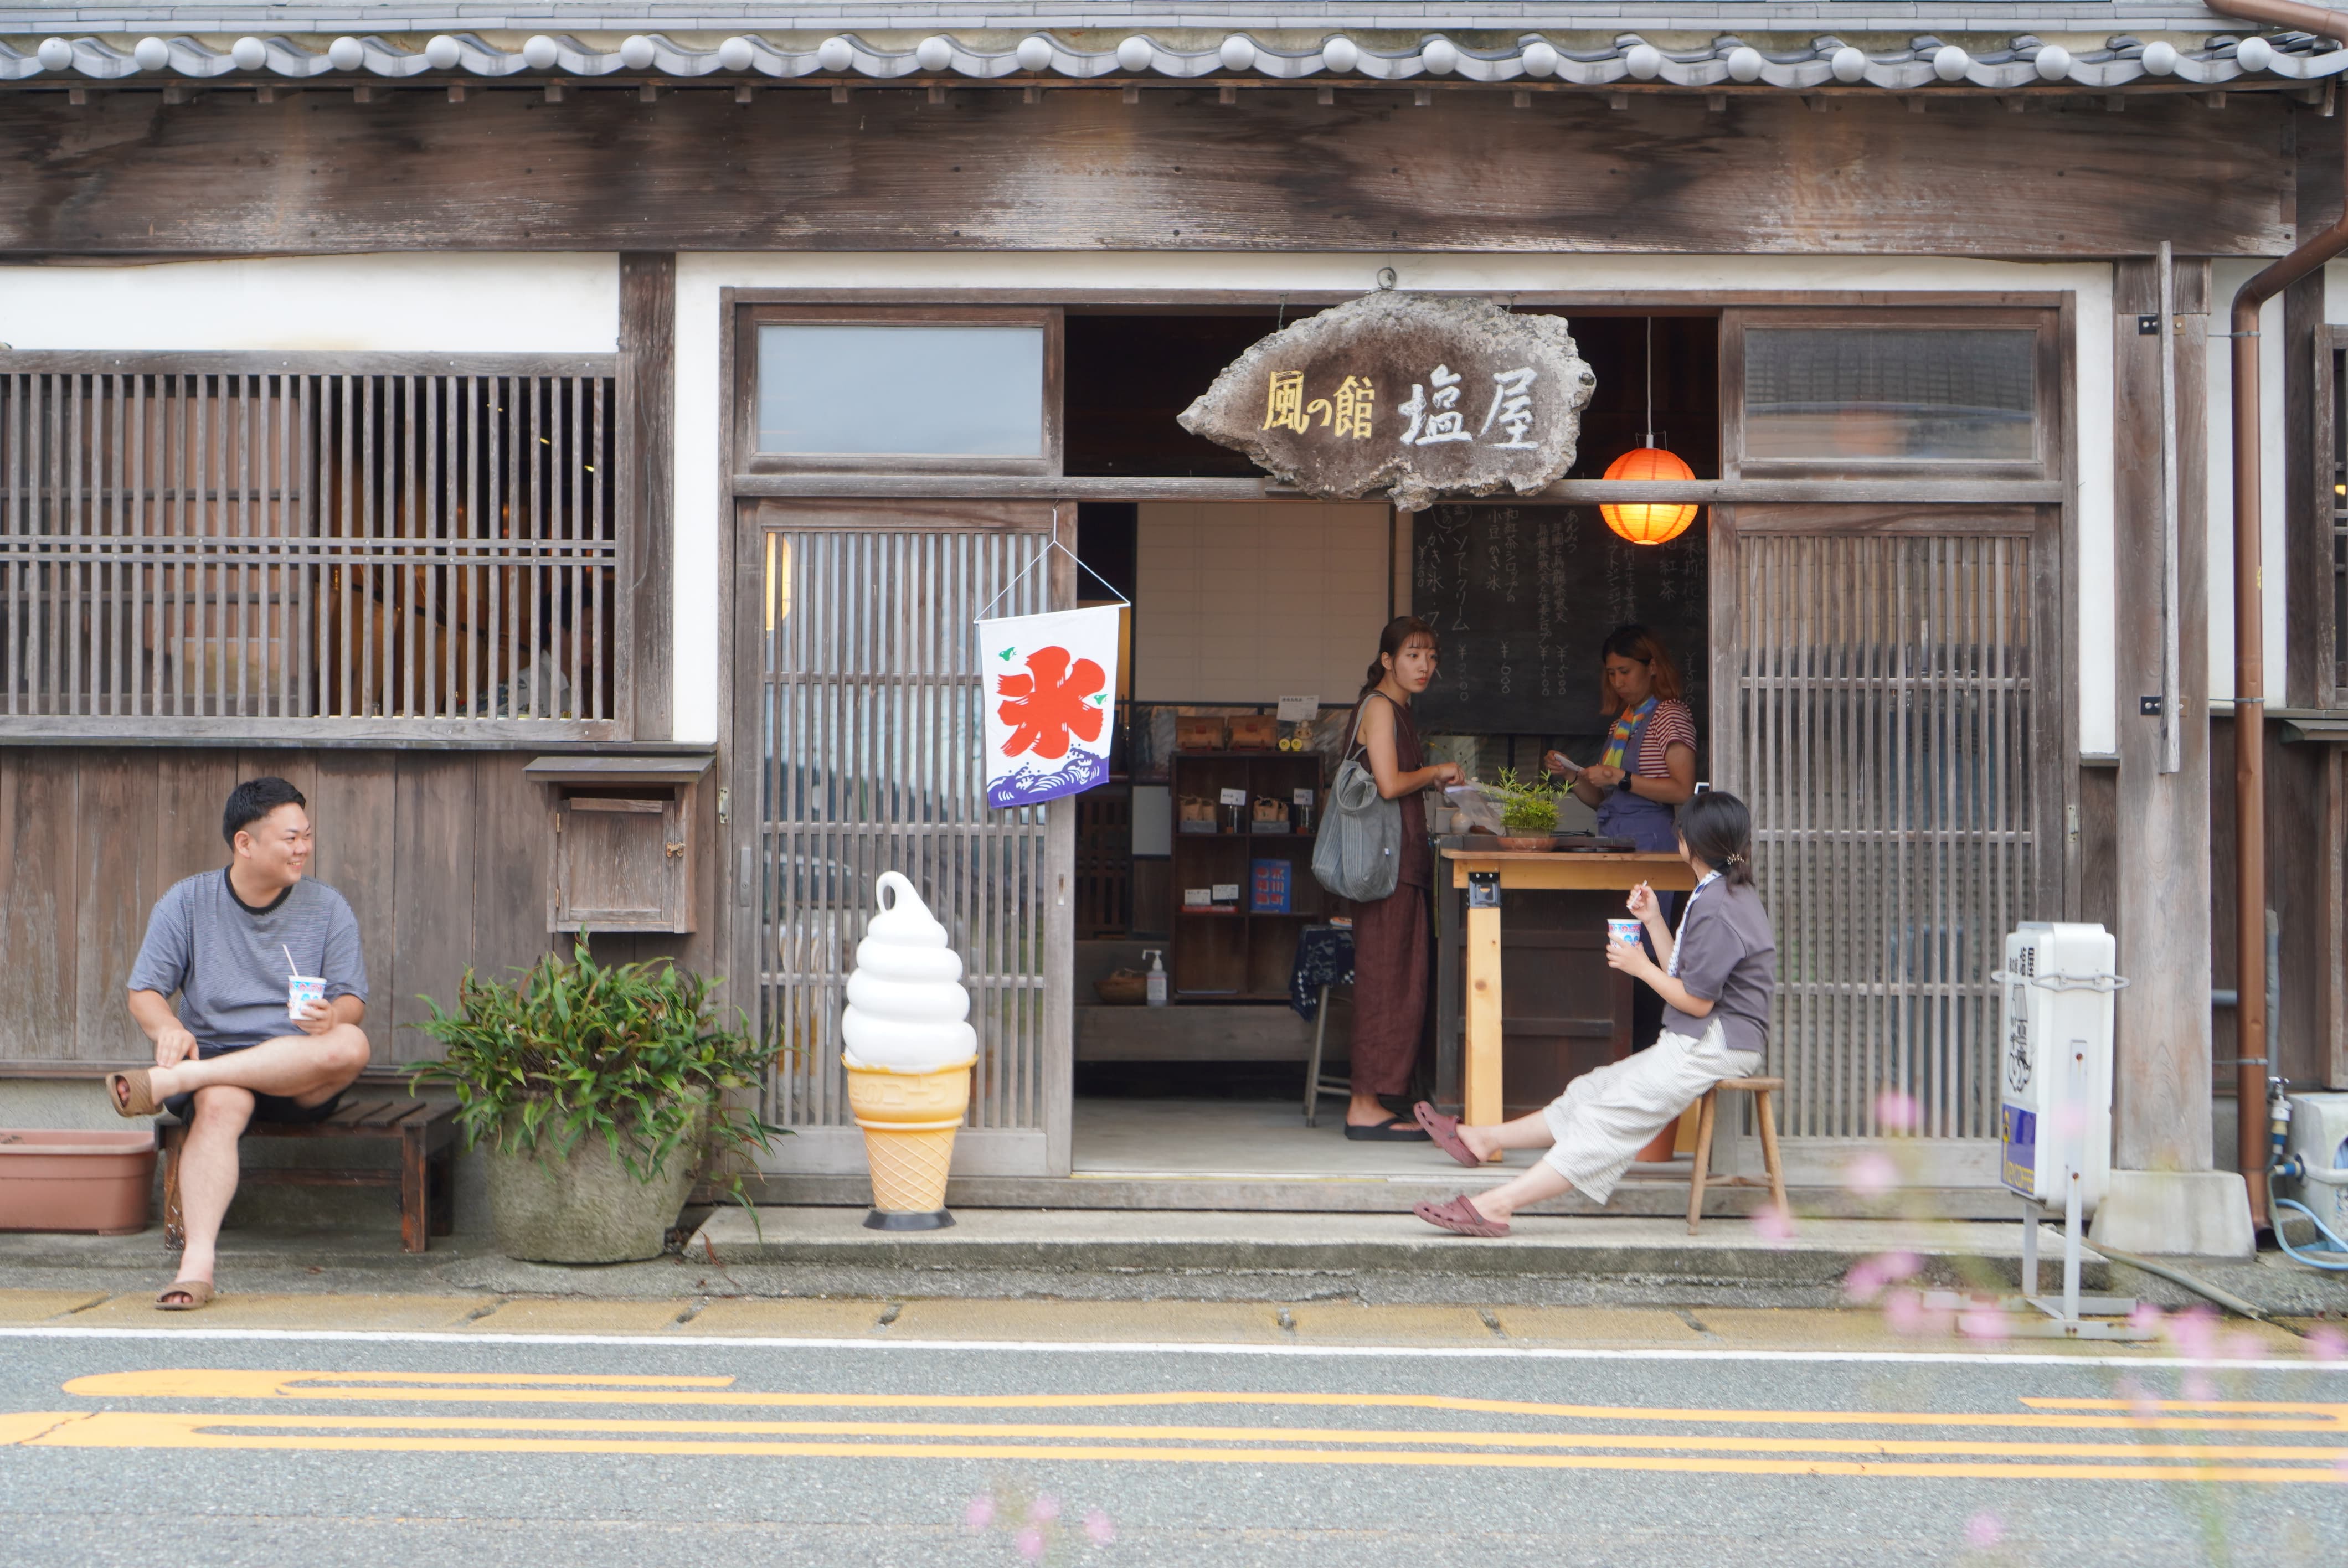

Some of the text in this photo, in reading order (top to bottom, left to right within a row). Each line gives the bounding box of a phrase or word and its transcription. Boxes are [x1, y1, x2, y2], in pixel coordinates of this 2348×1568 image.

[1262, 364, 1539, 449] 風の館 塩屋
[1564, 509, 1579, 554] あんみつ
[1451, 535, 1470, 631] ソフトクリーム
[1500, 640, 1511, 694] ¥600
[1556, 644, 1569, 696] ¥500
[996, 646, 1105, 760] 氷
